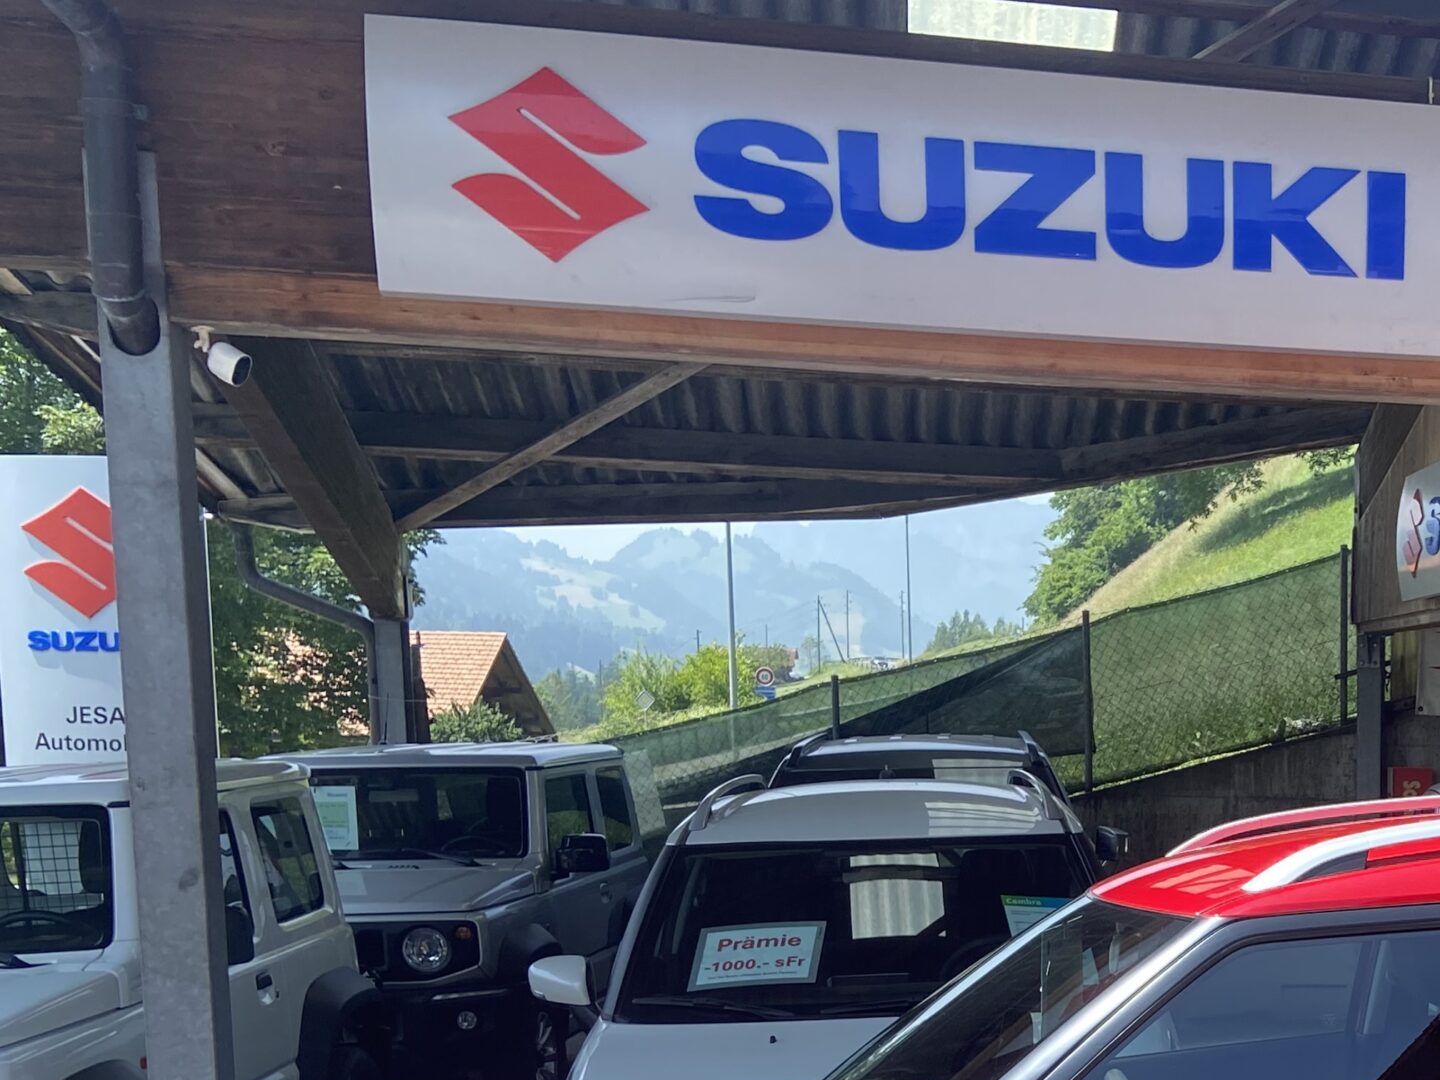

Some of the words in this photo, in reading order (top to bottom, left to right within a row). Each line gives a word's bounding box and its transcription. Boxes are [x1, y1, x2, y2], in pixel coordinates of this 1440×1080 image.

[694, 119, 1406, 280] SUZUKI
[66, 706, 125, 724] JESA
[1006, 897, 1042, 906] Cembra
[717, 934, 802, 952] Prämie
[775, 956, 806, 967] sFr
